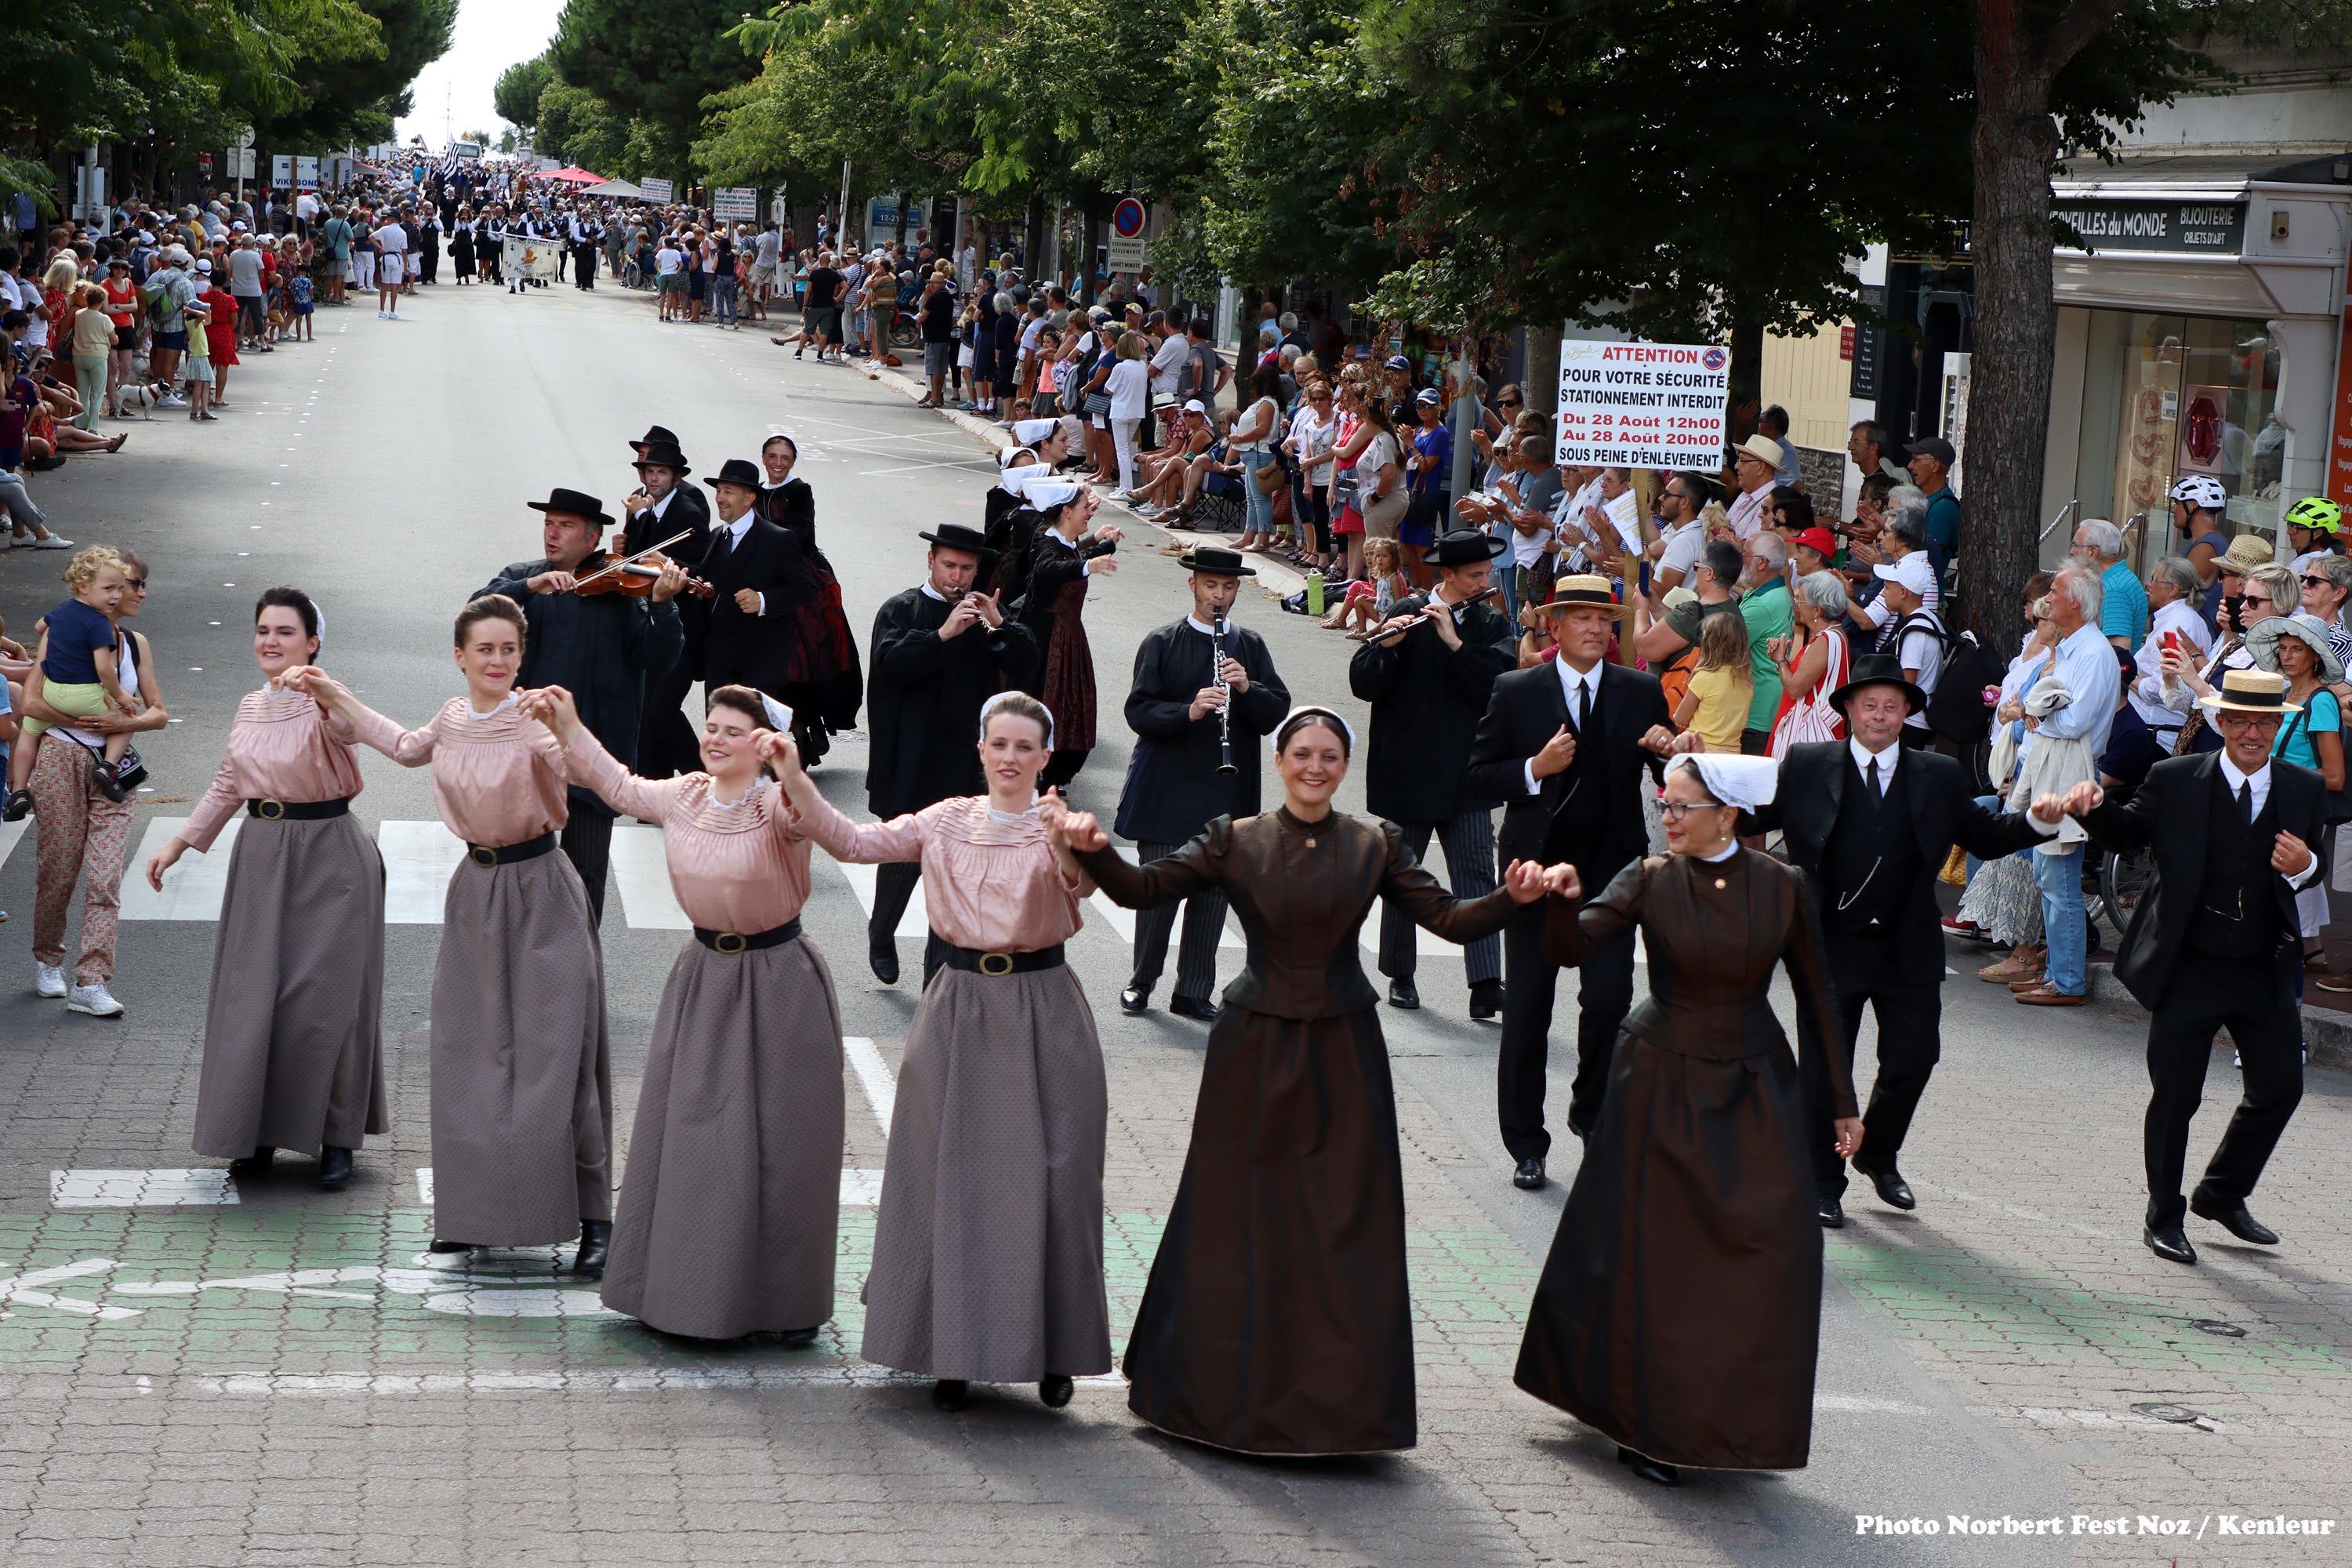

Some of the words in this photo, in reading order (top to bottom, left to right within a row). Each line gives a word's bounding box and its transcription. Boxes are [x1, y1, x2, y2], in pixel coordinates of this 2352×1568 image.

[2108, 211, 2121, 236] du
[2123, 212, 2168, 237] MONDE
[2180, 206, 2234, 226] BIJOUTERIE
[2183, 231, 2207, 245] OBJETS
[2207, 232, 2226, 245] D'ART
[1602, 347, 1697, 364] ATTENTION
[1563, 368, 1601, 383] POUR
[1606, 370, 1651, 385] VOTRE
[1656, 370, 1725, 388] SÉCURITÉ
[1561, 389, 1664, 408] STATIONNEMENT
[1668, 394, 1725, 409] INTERDIT
[1563, 413, 1586, 424] Du
[1592, 414, 1613, 426] 28
[1619, 416, 1661, 427] Août
[1667, 417, 1720, 430] 12h00
[1563, 430, 1585, 441] Au
[1592, 430, 1613, 442] 28
[1618, 431, 1660, 444] Août
[1665, 433, 1720, 446] 20h00
[1559, 447, 1591, 462] SOUS
[1594, 449, 1628, 463] PEINE
[1631, 449, 1719, 467] D'ENLÈVEMENT
